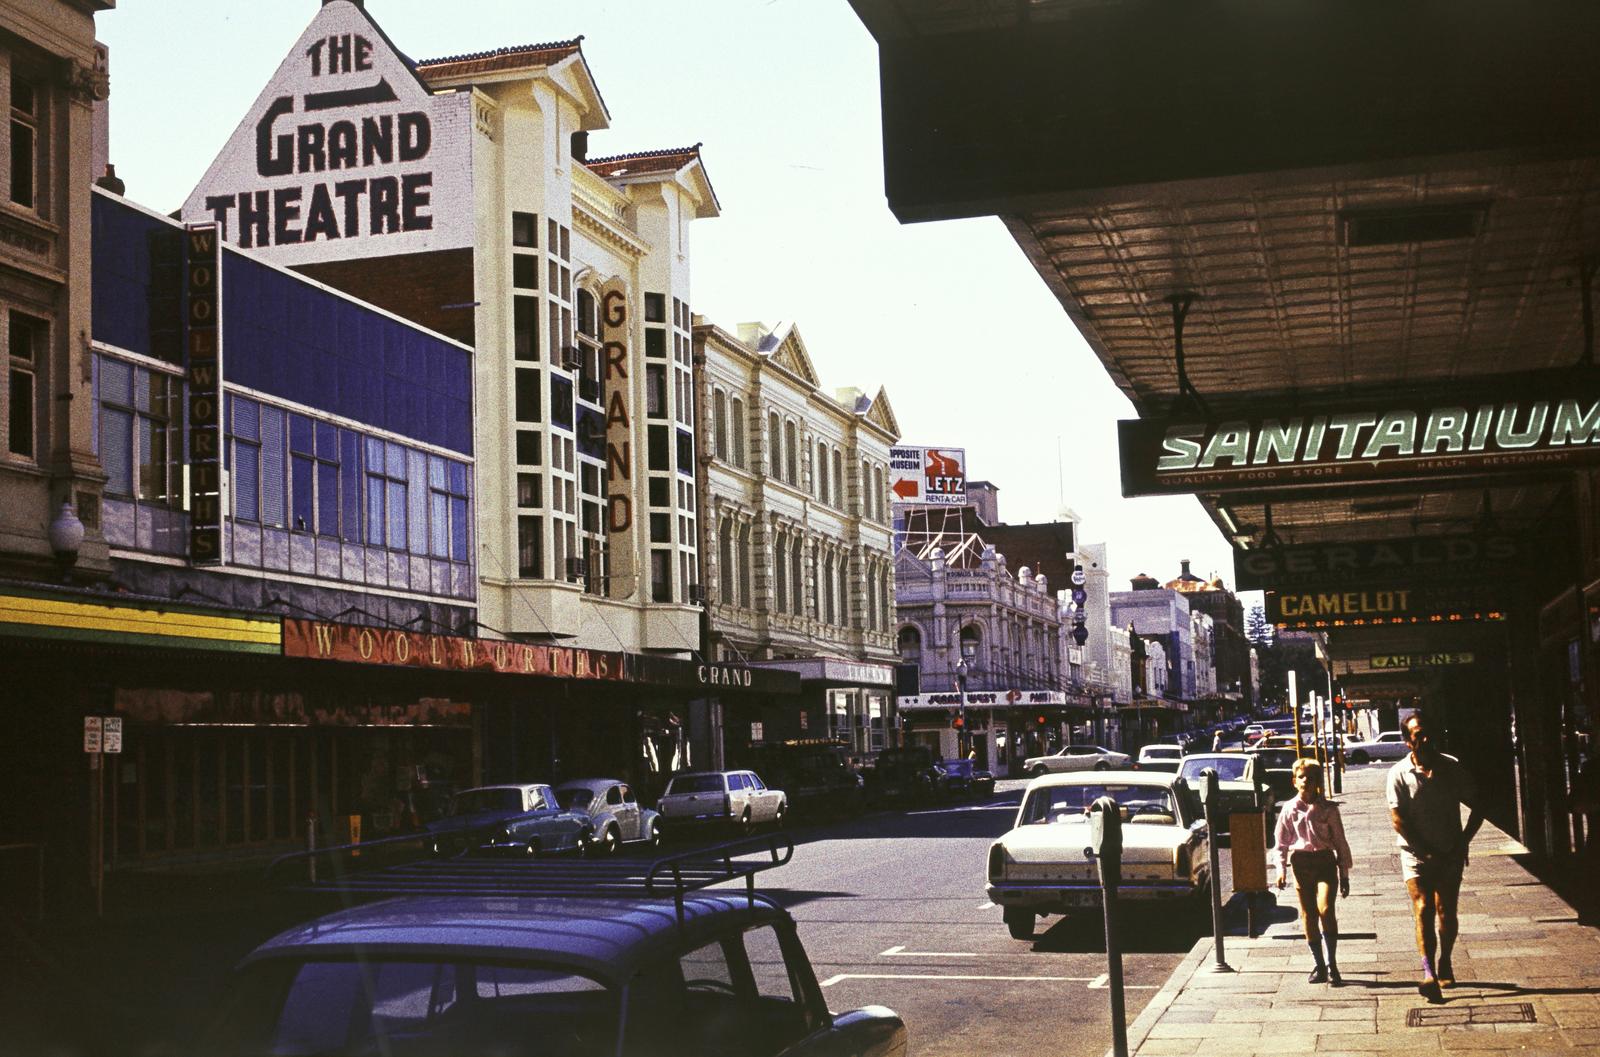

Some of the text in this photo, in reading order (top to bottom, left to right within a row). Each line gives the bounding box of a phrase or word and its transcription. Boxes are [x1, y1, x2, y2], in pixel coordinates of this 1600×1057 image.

[306, 33, 373, 76] THE
[256, 95, 431, 177] GRAND
[205, 171, 433, 249] THEATRE
[191, 233, 214, 554] WOOLWORTHS
[603, 289, 632, 533] GRAND
[1156, 399, 1600, 471] SANITARIUM
[889, 460, 920, 470] MUSEUM
[1161, 466, 1344, 486] QUALITY FOOD STORE
[1417, 451, 1570, 469] HEALTH RESTAURANT
[926, 476, 964, 492] LETZ
[1244, 536, 1516, 576] GERALDS
[1280, 590, 1410, 616] CAMELOT
[315, 625, 608, 677] WOOLWORTHS
[697, 665, 752, 687] GRAND
